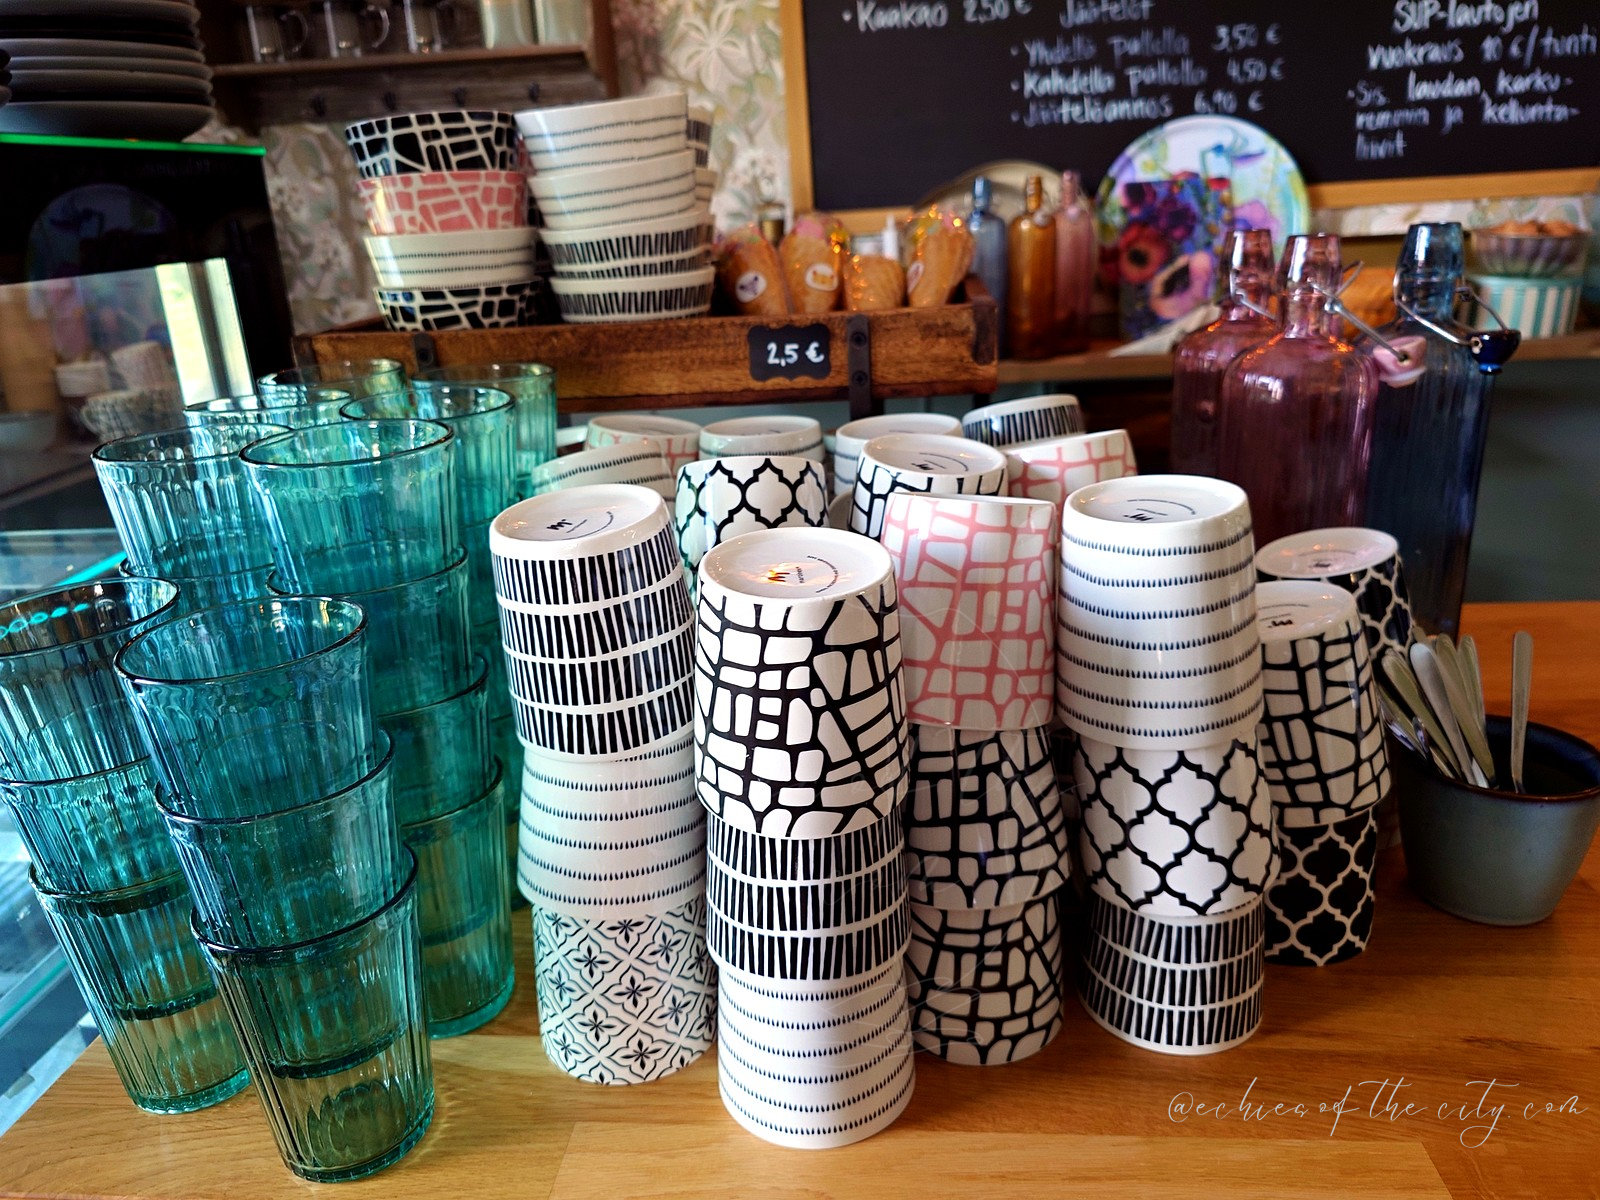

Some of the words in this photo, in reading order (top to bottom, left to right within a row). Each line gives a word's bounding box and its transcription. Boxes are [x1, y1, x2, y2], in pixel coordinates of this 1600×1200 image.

[857, 1, 949, 32] Kaakao
[1266, 23, 1282, 45] €
[766, 341, 799, 367] 2,5
[805, 341, 824, 363] €
